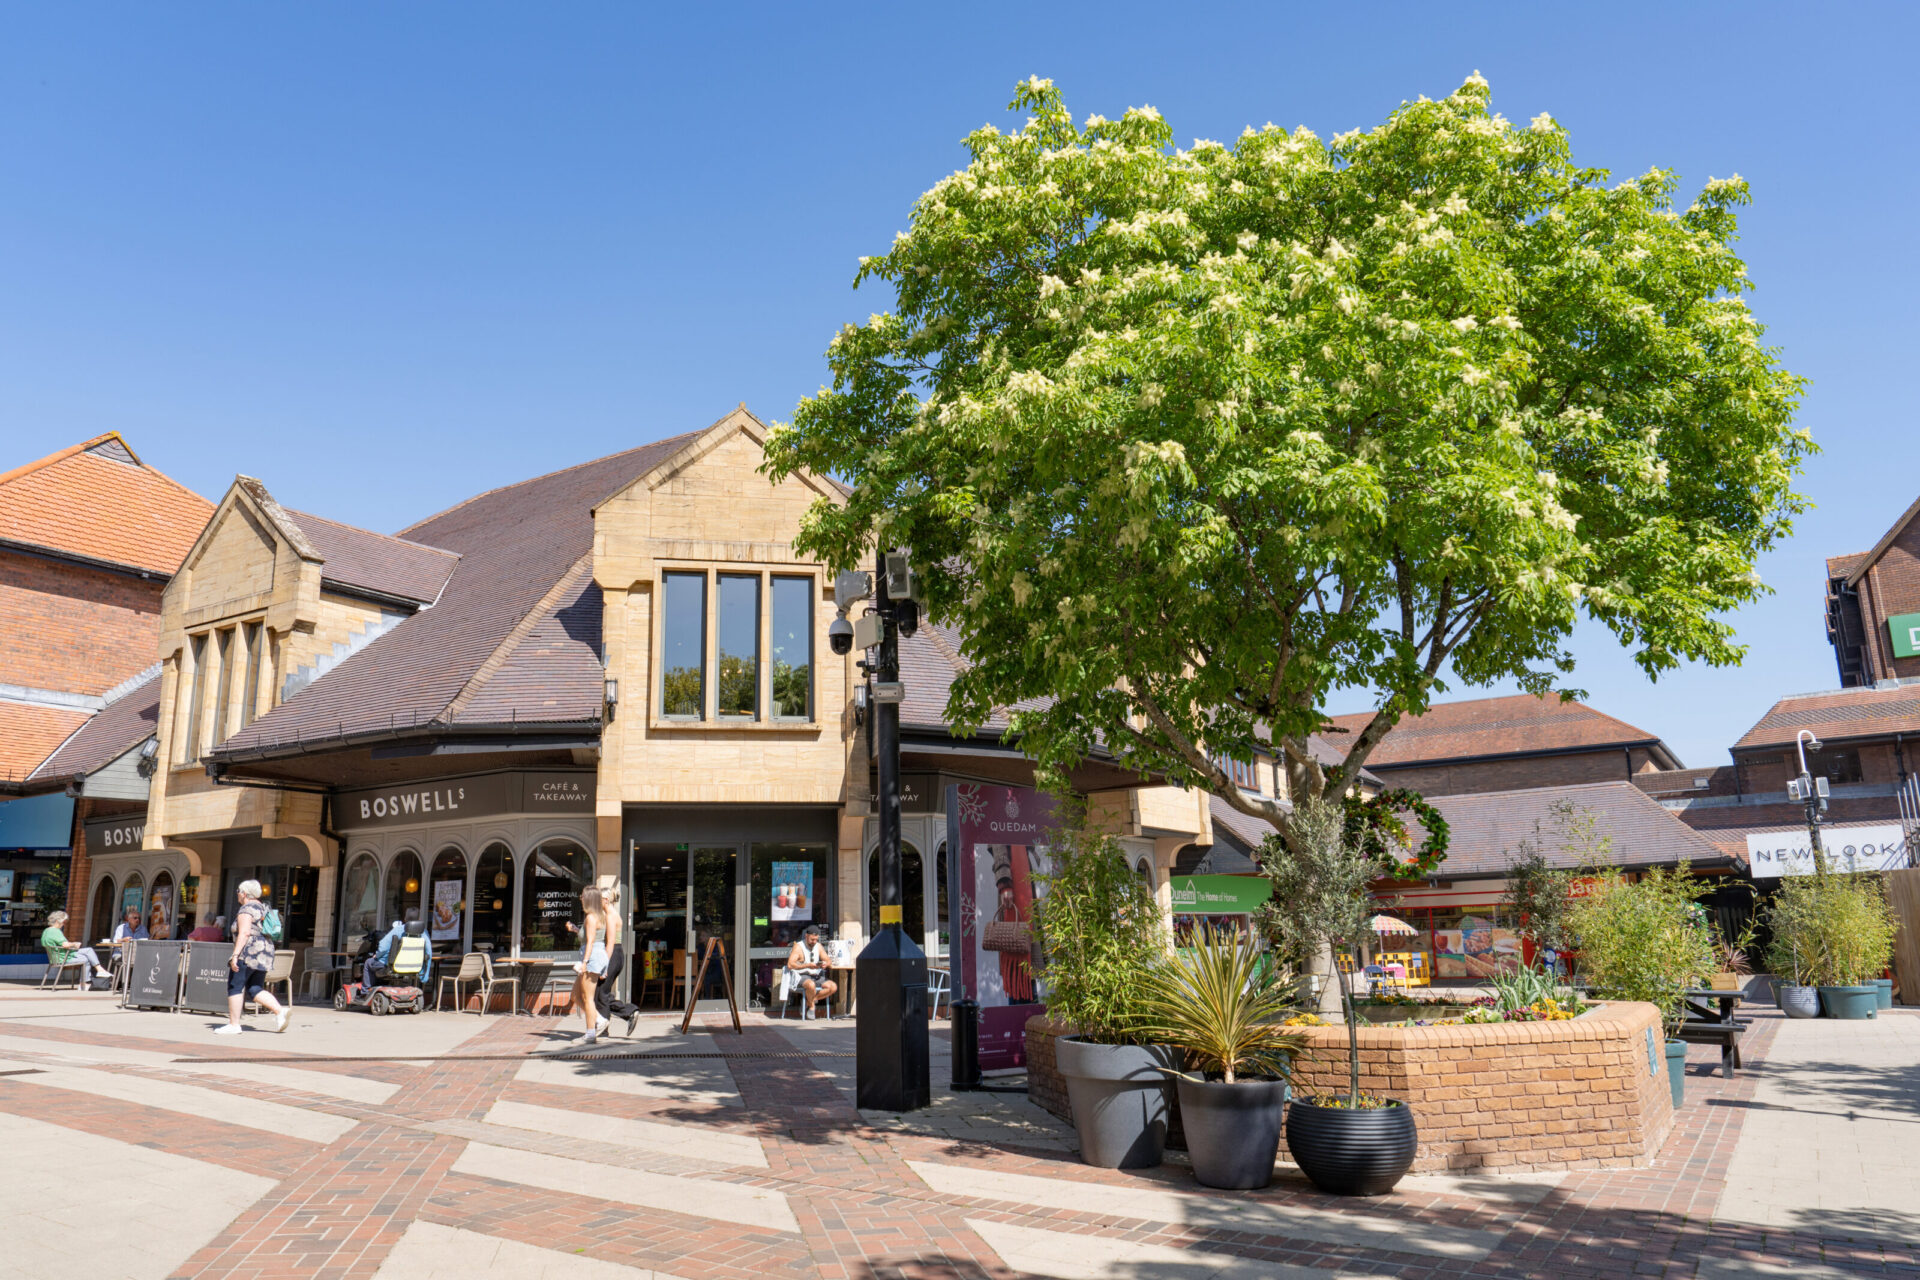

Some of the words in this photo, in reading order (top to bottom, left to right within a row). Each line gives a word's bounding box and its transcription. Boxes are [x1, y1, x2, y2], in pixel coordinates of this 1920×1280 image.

[542, 781, 568, 791] CAFÉ
[572, 783, 579, 791] &
[904, 784, 911, 792] &
[533, 793, 588, 801] TAKEAWAY
[870, 793, 919, 802] TAWAY
[360, 788, 465, 819] BOSWELLS
[989, 821, 1036, 833] QUEDAM
[1756, 847, 1812, 863] NEW
[1827, 842, 1898, 858] LOOK
[536, 891, 579, 899] ADDITIONAL
[1206, 891, 1219, 902] Home
[1224, 892, 1238, 902] Homes
[541, 910, 573, 918] UPSTAIRS
